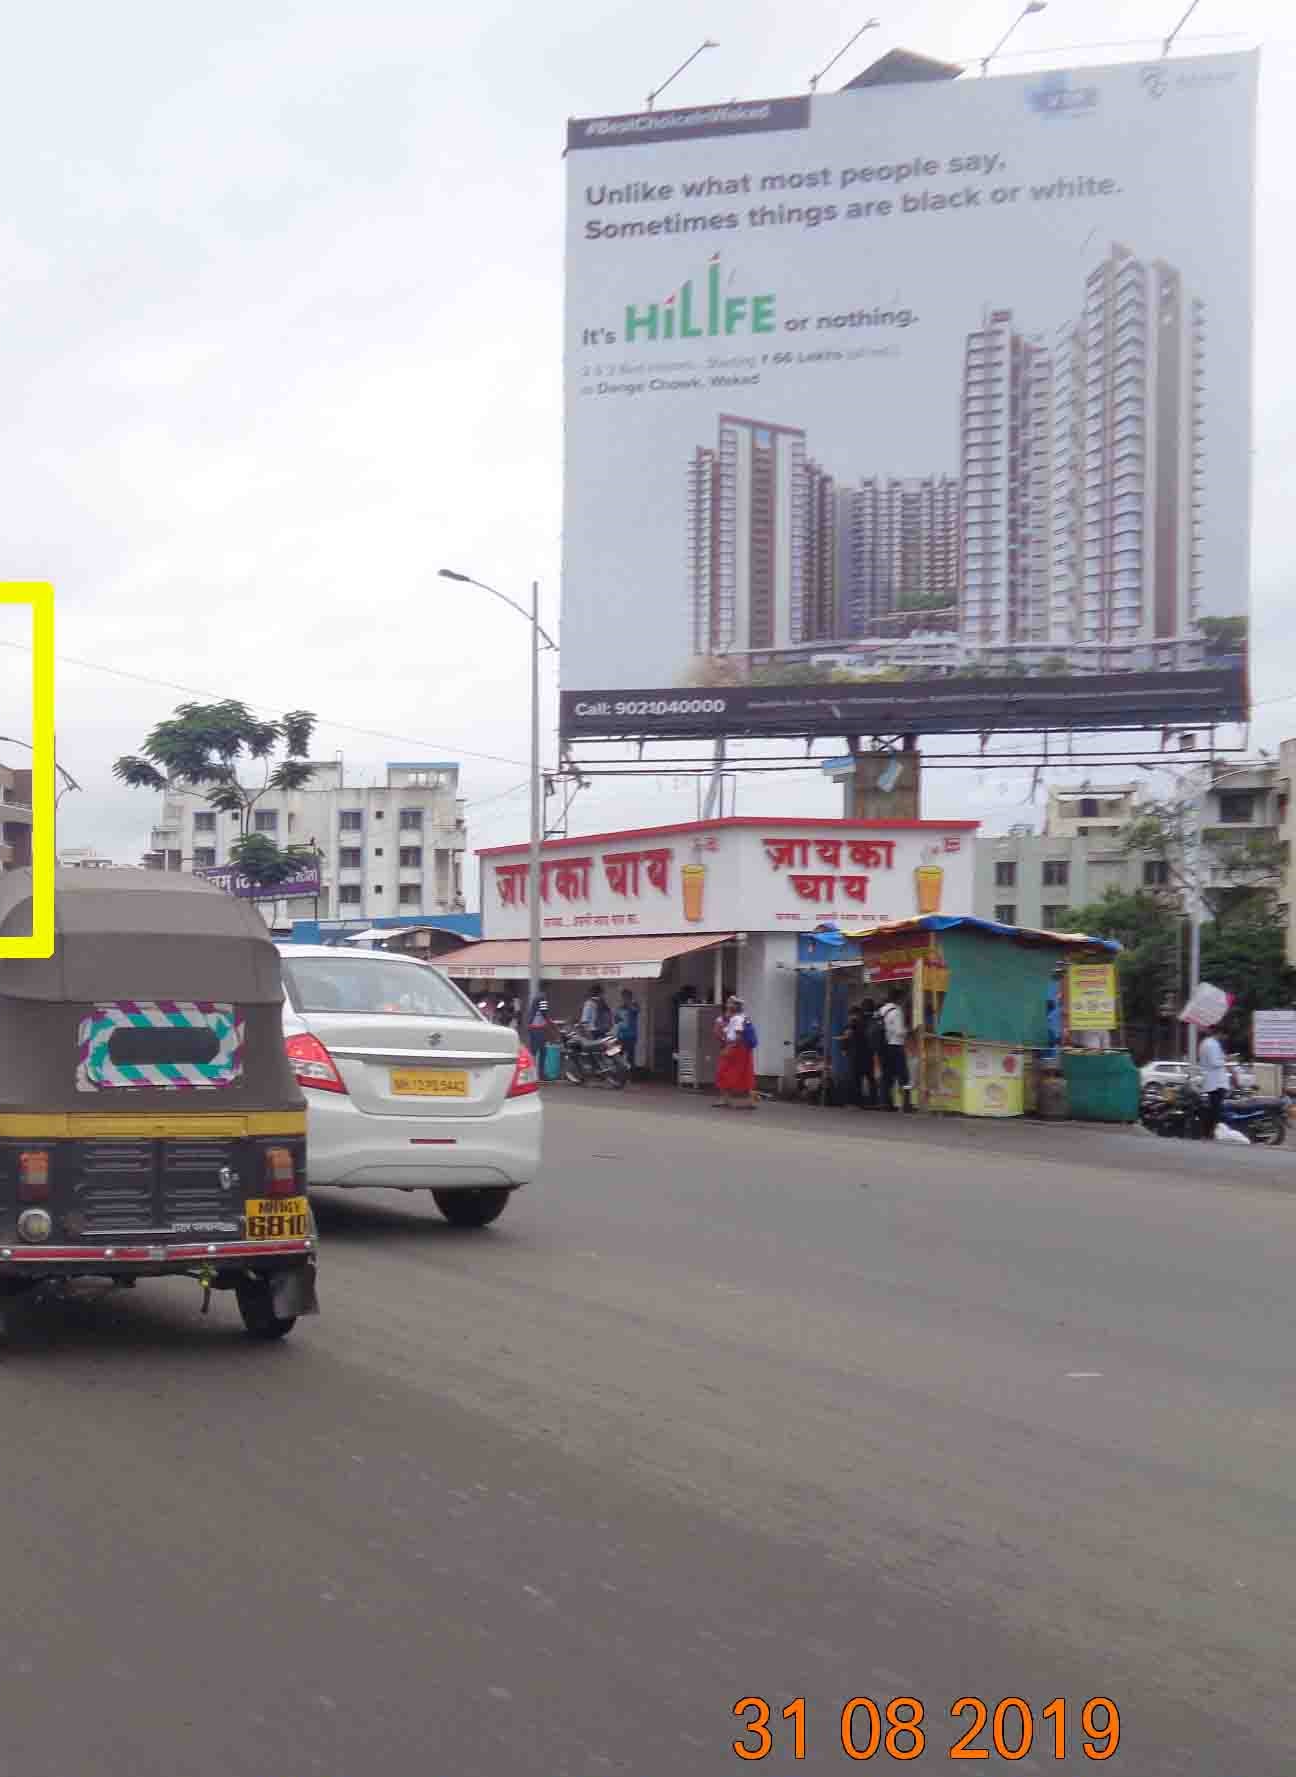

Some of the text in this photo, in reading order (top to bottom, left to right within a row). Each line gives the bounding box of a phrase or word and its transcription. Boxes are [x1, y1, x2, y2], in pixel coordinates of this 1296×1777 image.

[584, 182, 674, 206] Unlike
[680, 174, 752, 199] what
[759, 167, 832, 191] most
[839, 157, 940, 190] people
[584, 174, 1125, 241] Sometimes things are black or white.
[783, 316, 809, 332] or
[815, 306, 921, 331] nothing.
[574, 699, 726, 717] Call: 9021040000
[601, 847, 672, 896] चाय
[787, 874, 870, 904] चाय
